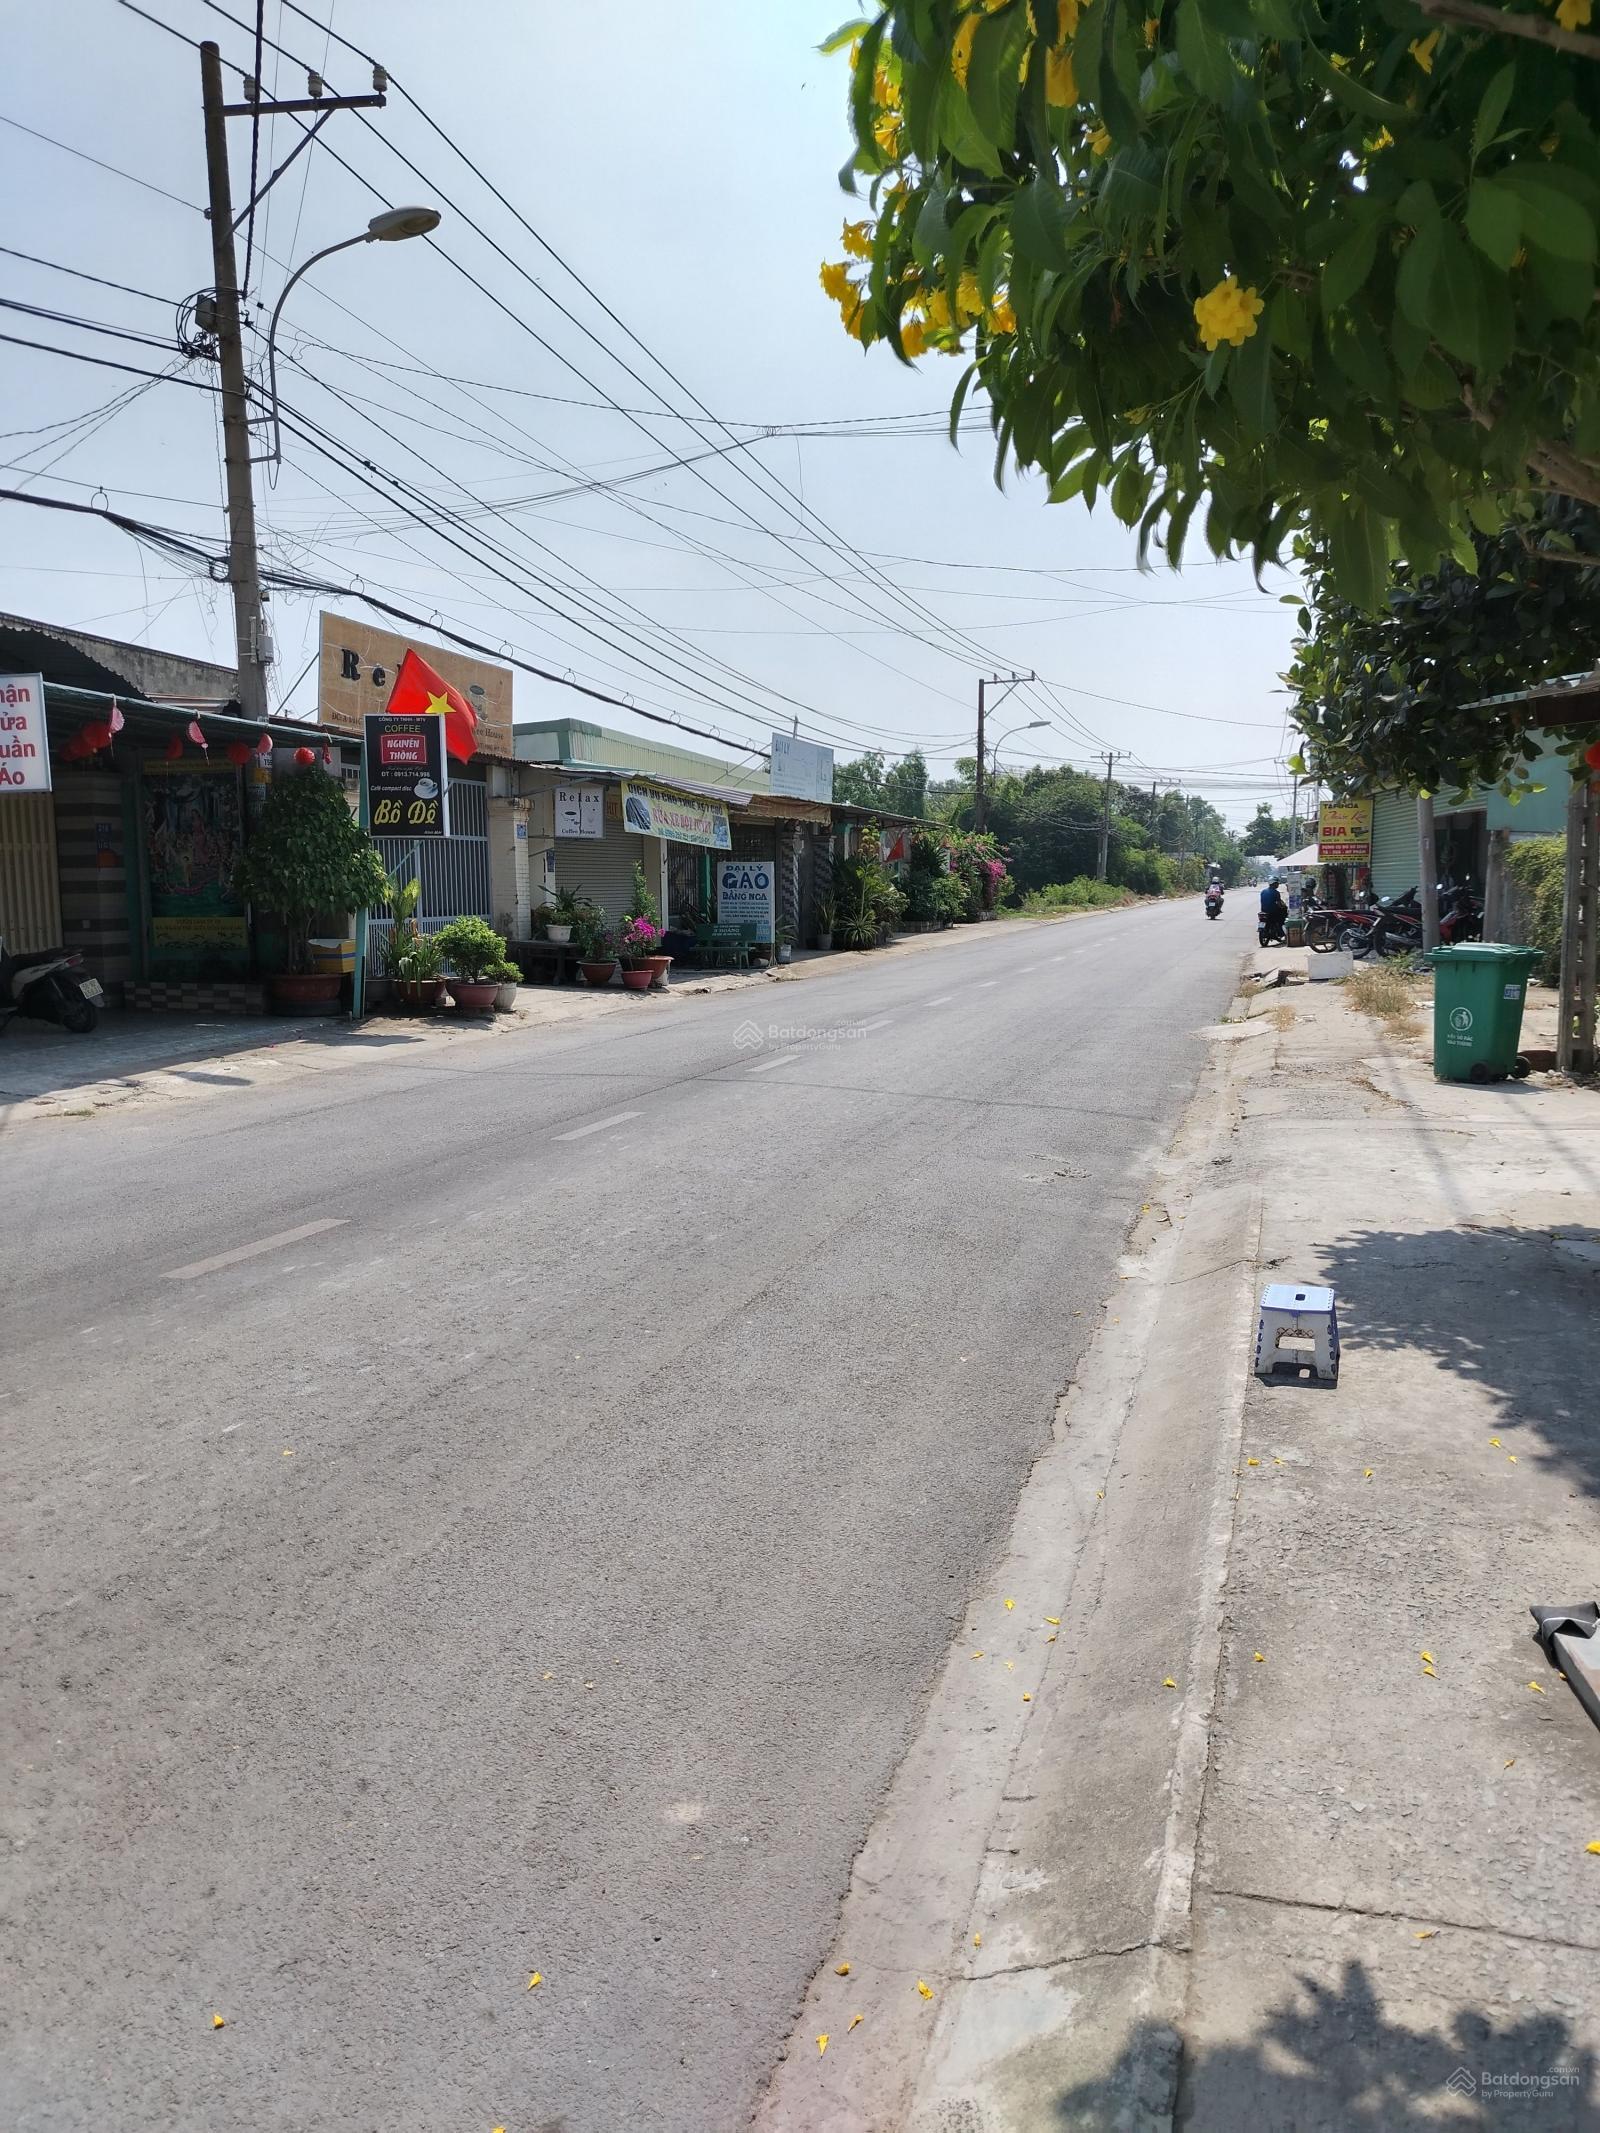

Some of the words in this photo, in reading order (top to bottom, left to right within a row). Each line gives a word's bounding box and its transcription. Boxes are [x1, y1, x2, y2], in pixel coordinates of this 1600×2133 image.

[384, 724, 420, 733] COFFEE
[389, 751, 418, 760] THÔNG
[629, 783, 648, 797] DỊCH
[559, 791, 600, 803] Relax
[374, 799, 403, 825] Bồ
[407, 799, 439, 825] Đề
[1323, 826, 1347, 837] BIA
[726, 865, 746, 873] ĐẠI
[749, 863, 764, 872] LÝ
[722, 872, 770, 890] GẠO
[748, 892, 768, 901] NGA
